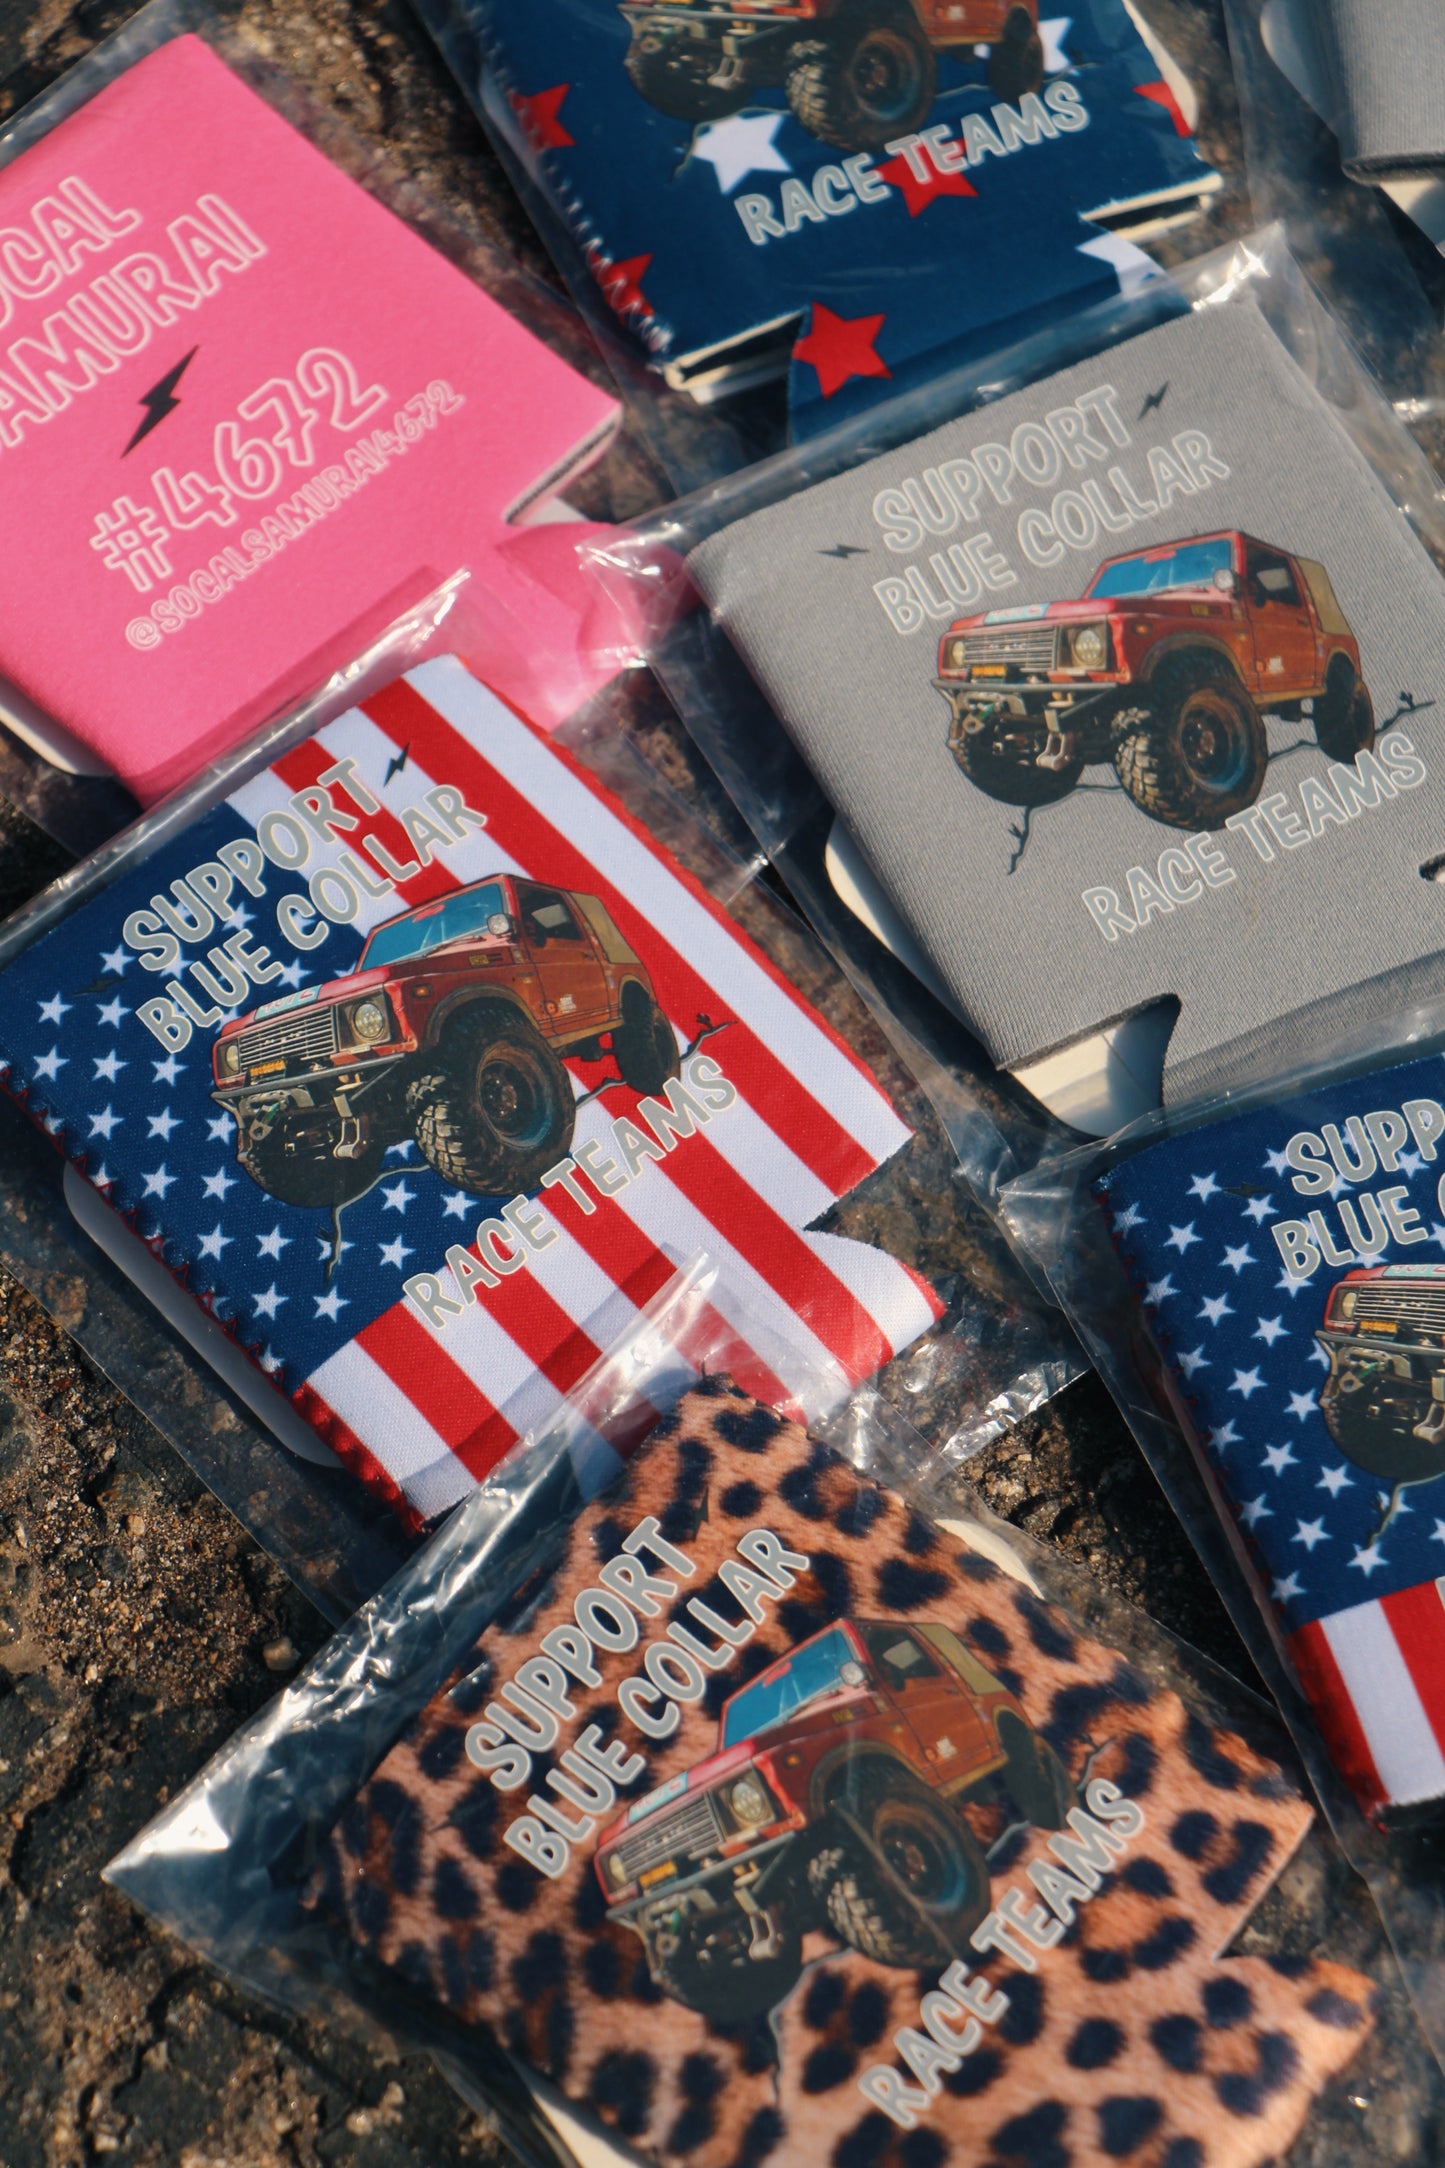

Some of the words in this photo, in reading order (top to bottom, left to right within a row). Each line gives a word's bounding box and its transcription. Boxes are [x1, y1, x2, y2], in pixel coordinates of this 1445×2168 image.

[734, 151, 890, 245] RACE
[884, 80, 1090, 185] TEAMS
[89, 347, 389, 593] #4672
[125, 378, 465, 650] @SOCALSAMURAI4672
[872, 384, 1133, 553] SUPPORT
[872, 533, 1016, 635] BLUE
[1016, 429, 1231, 568] COLLAR
[122, 756, 383, 973] SUPPORT
[135, 928, 284, 1054] BLUE
[276, 782, 488, 951] COLLAR
[1081, 830, 1237, 942] RACE
[1225, 731, 1428, 863] TEAMS
[402, 1194, 559, 1331] RACE
[540, 1054, 739, 1216] TEAMS
[1271, 1185, 1429, 1280] BLUE
[1284, 1099, 1445, 1196] SUPP
[464, 1515, 697, 1791] SUPPORT
[503, 1726, 646, 1879] BLUE
[617, 1528, 810, 1740] COLLAR
[858, 1959, 1009, 2129] RACE
[970, 1778, 1147, 1973] TEAMS
